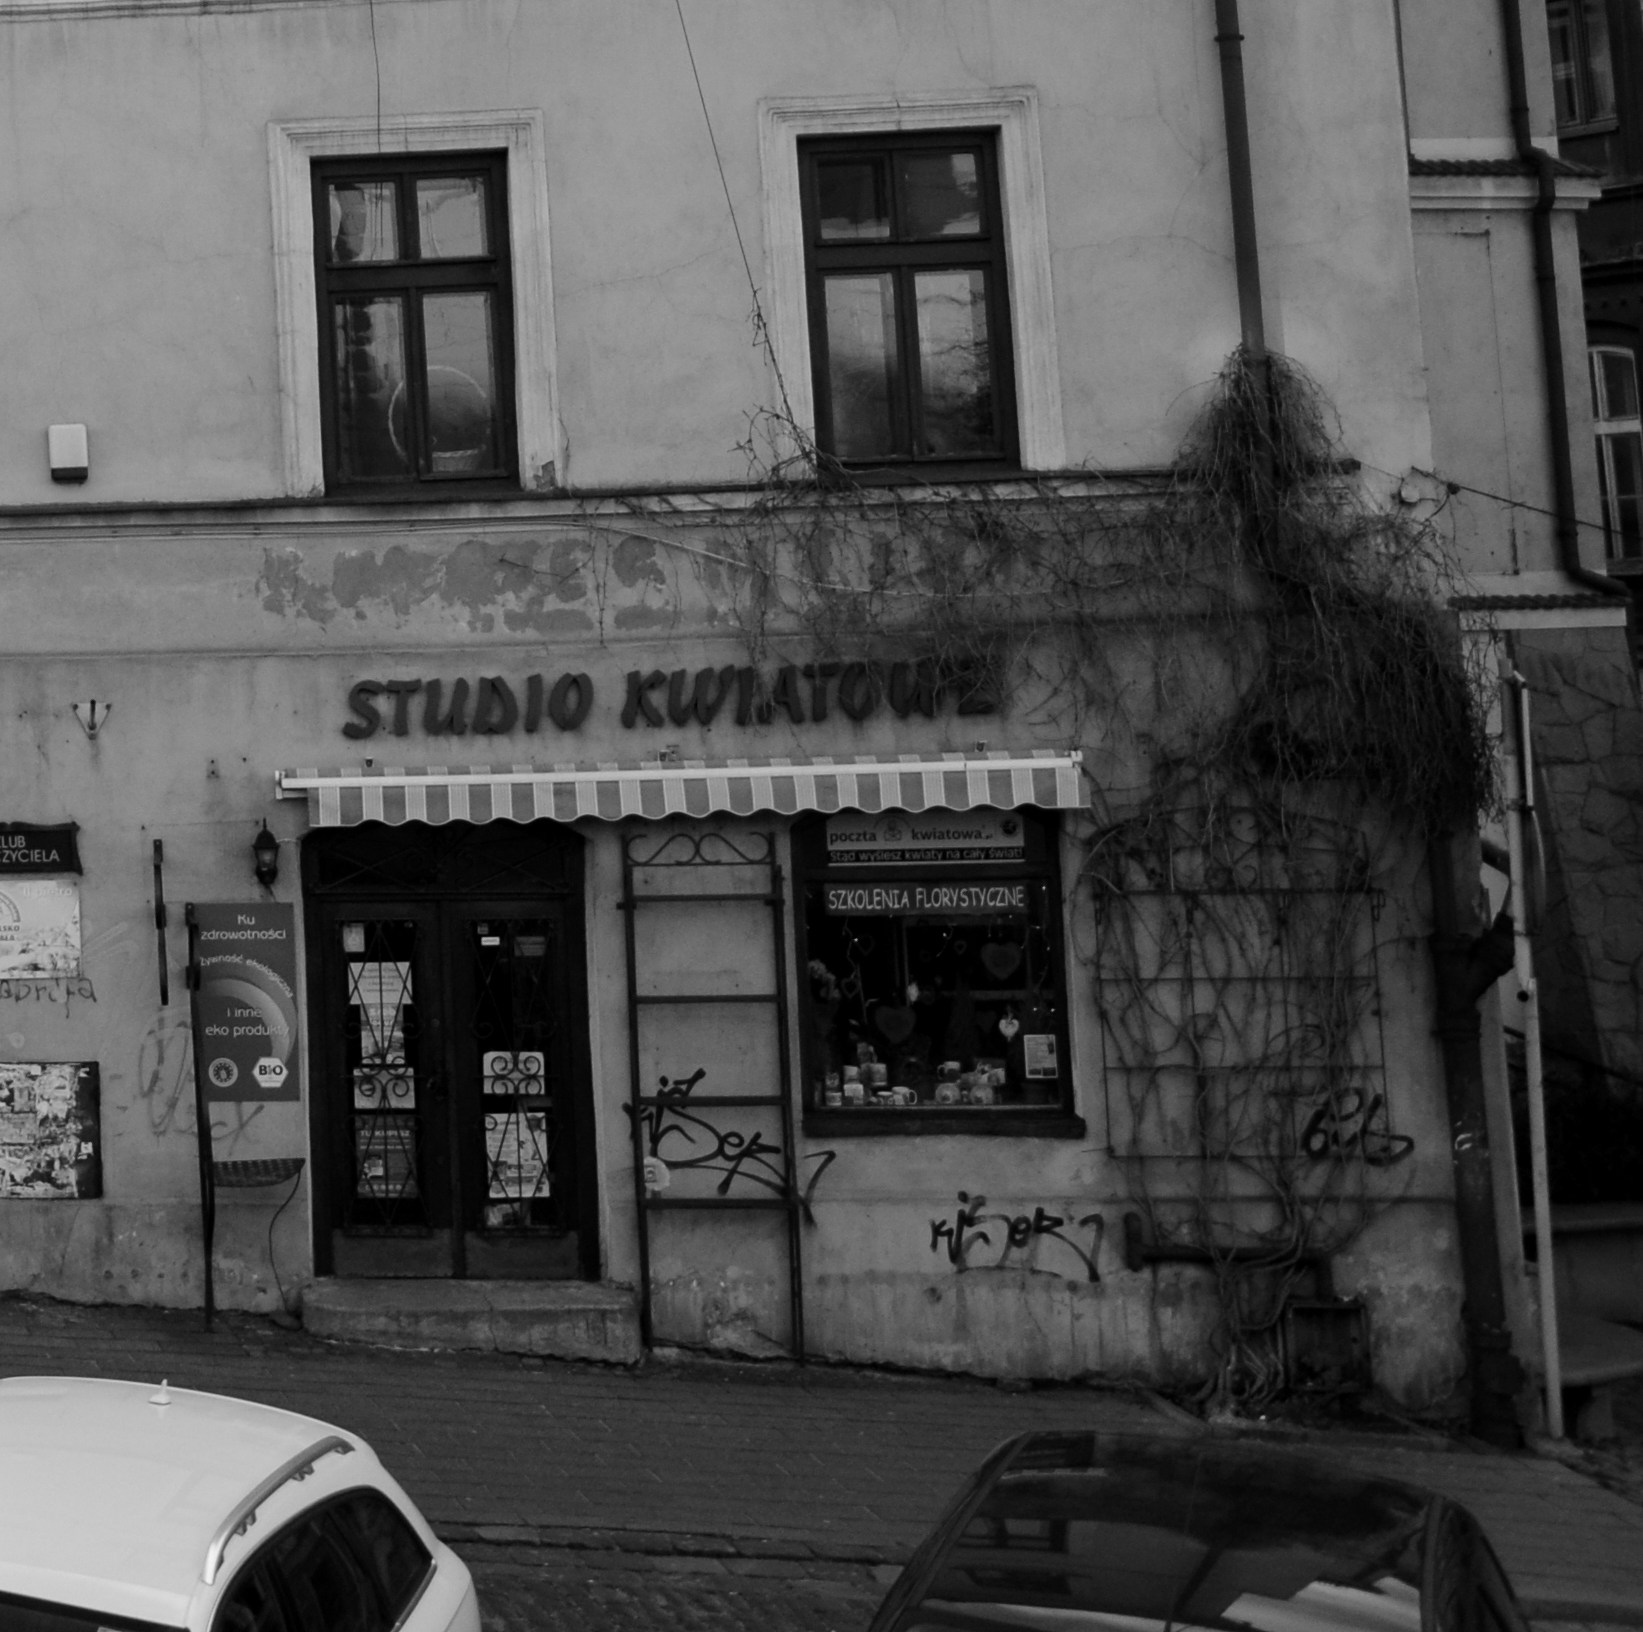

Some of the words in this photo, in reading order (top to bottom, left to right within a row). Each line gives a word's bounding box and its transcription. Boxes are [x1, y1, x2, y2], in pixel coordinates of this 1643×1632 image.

[342, 672, 594, 741] STUDIO
[829, 830, 877, 845] poczta
[904, 848, 943, 862] kwiaty
[946, 850, 961, 860] na
[829, 888, 910, 910] SZKOLENIA
[915, 885, 1025, 909] FLORYSTYCZNE
[237, 914, 256, 925] Ku
[201, 928, 286, 941] zdrowotności
[234, 1007, 263, 1018] inne
[205, 1025, 229, 1037] eko
[233, 1024, 290, 1039] produkty
